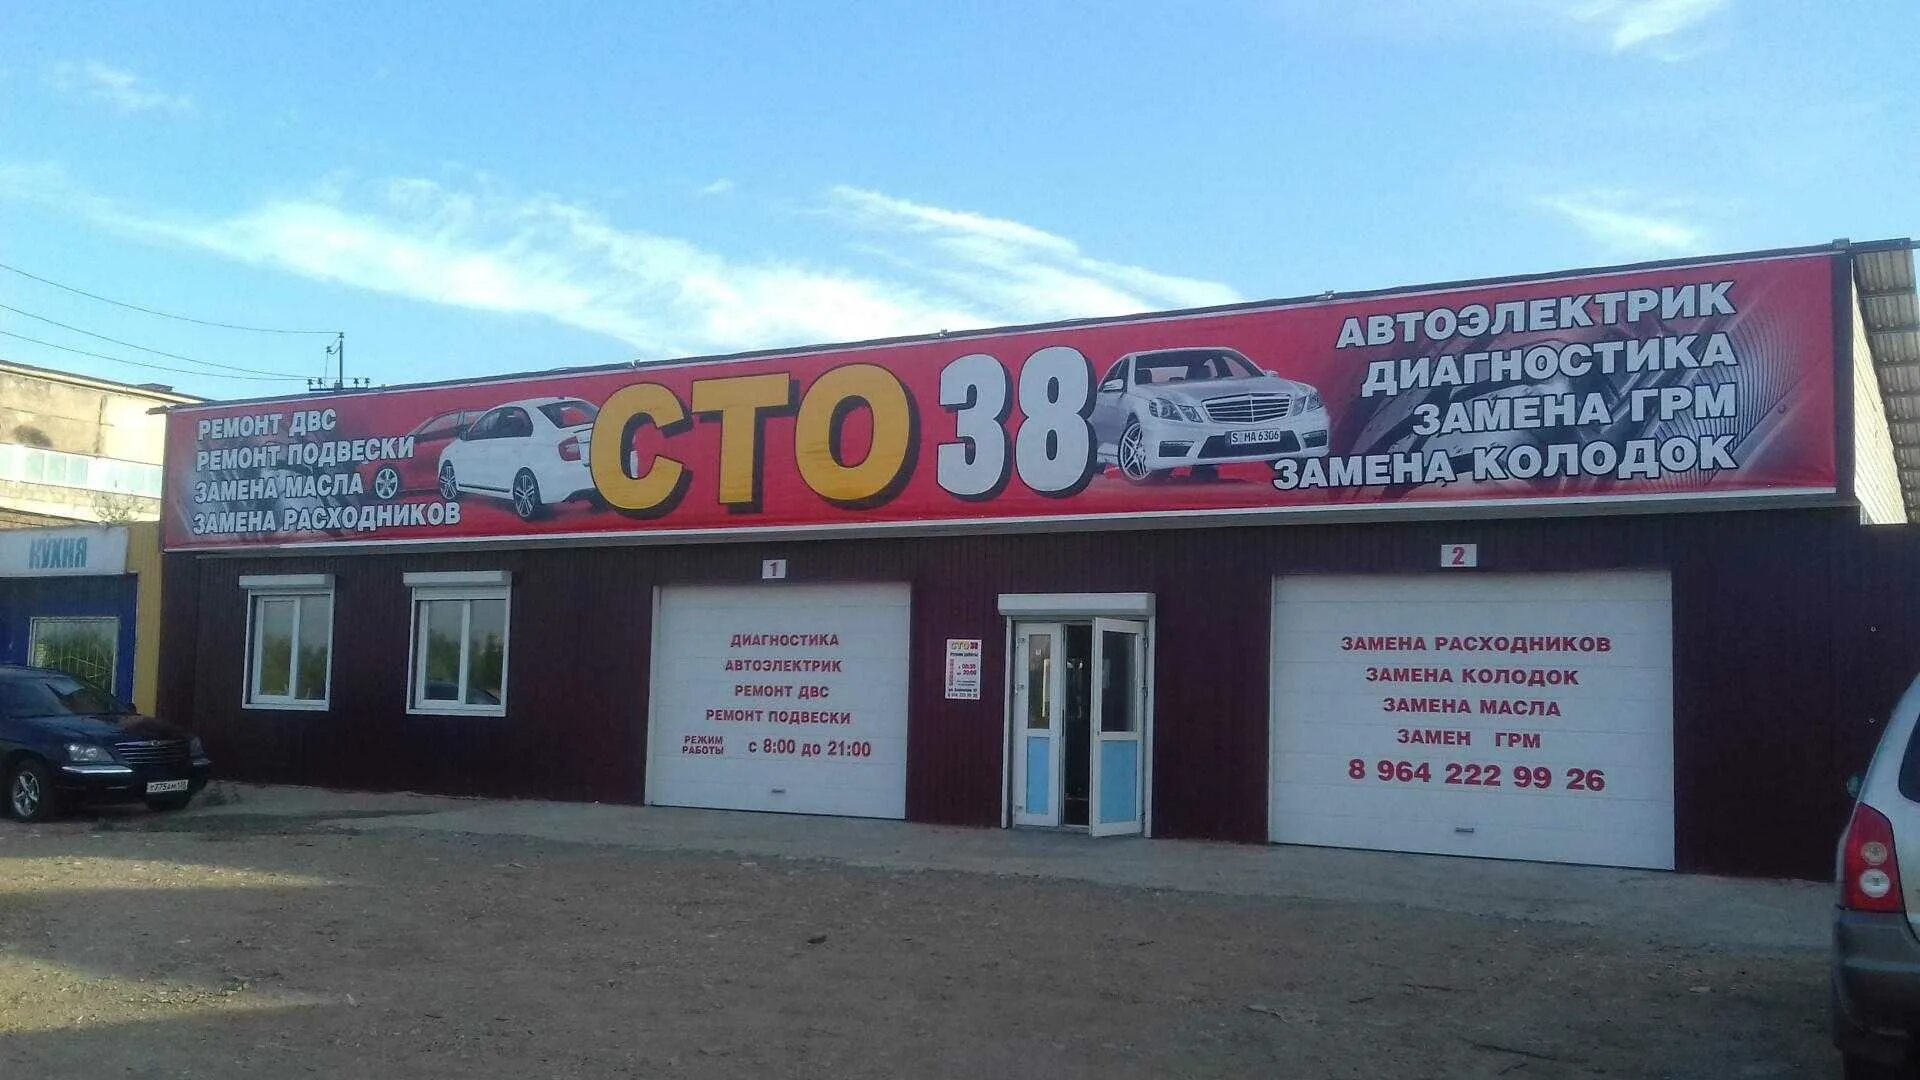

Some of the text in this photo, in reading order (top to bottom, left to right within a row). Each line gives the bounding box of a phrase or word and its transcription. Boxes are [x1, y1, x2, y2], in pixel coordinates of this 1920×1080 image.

[1335, 280, 1736, 350] АВТОЭЛЕКТРИК
[1361, 332, 1738, 399] ДИАГНОСТИКА
[1412, 383, 1738, 437] ЗАМЕНА ГРМ
[197, 408, 338, 441] РЕМОНТ ДВС
[590, 346, 1090, 512] СТО 38
[196, 435, 415, 472] РЕМОНТ ПОДВЕСКИ
[1273, 434, 1739, 490] ЗАМЕНА КОЛОДОК
[194, 472, 364, 504] ЗАМЕНА МАСЛА
[193, 501, 462, 536] ЗАМЕНА РАСХОДНИКОВ
[1451, 546, 1466, 565] 2
[769, 561, 779, 577] 1
[730, 632, 840, 648] ДИАГНОСТИКА
[1341, 636, 1612, 654] ЗАМЕНА РАСХОДНИКОВ
[725, 659, 842, 673] АВТОЭЛЕКТРИК
[1366, 667, 1580, 688] ЗАМЕНА КОЛОДОК
[734, 684, 830, 700] РЕМОНТ ДВС
[705, 709, 851, 726] РЕМОНТ ПОДВЕСКИ
[1383, 698, 1562, 717] ЗАМЕНА МАСЛА
[684, 735, 723, 745] РЕЖИМ
[763, 738, 796, 754] 8:00
[801, 742, 821, 756] до
[827, 741, 872, 757] 21:00
[1397, 729, 1541, 749] ЗАМЕН ГРМ
[682, 745, 724, 755] РАБОТЫ
[1348, 758, 1606, 792] 8 964 222 99 26
